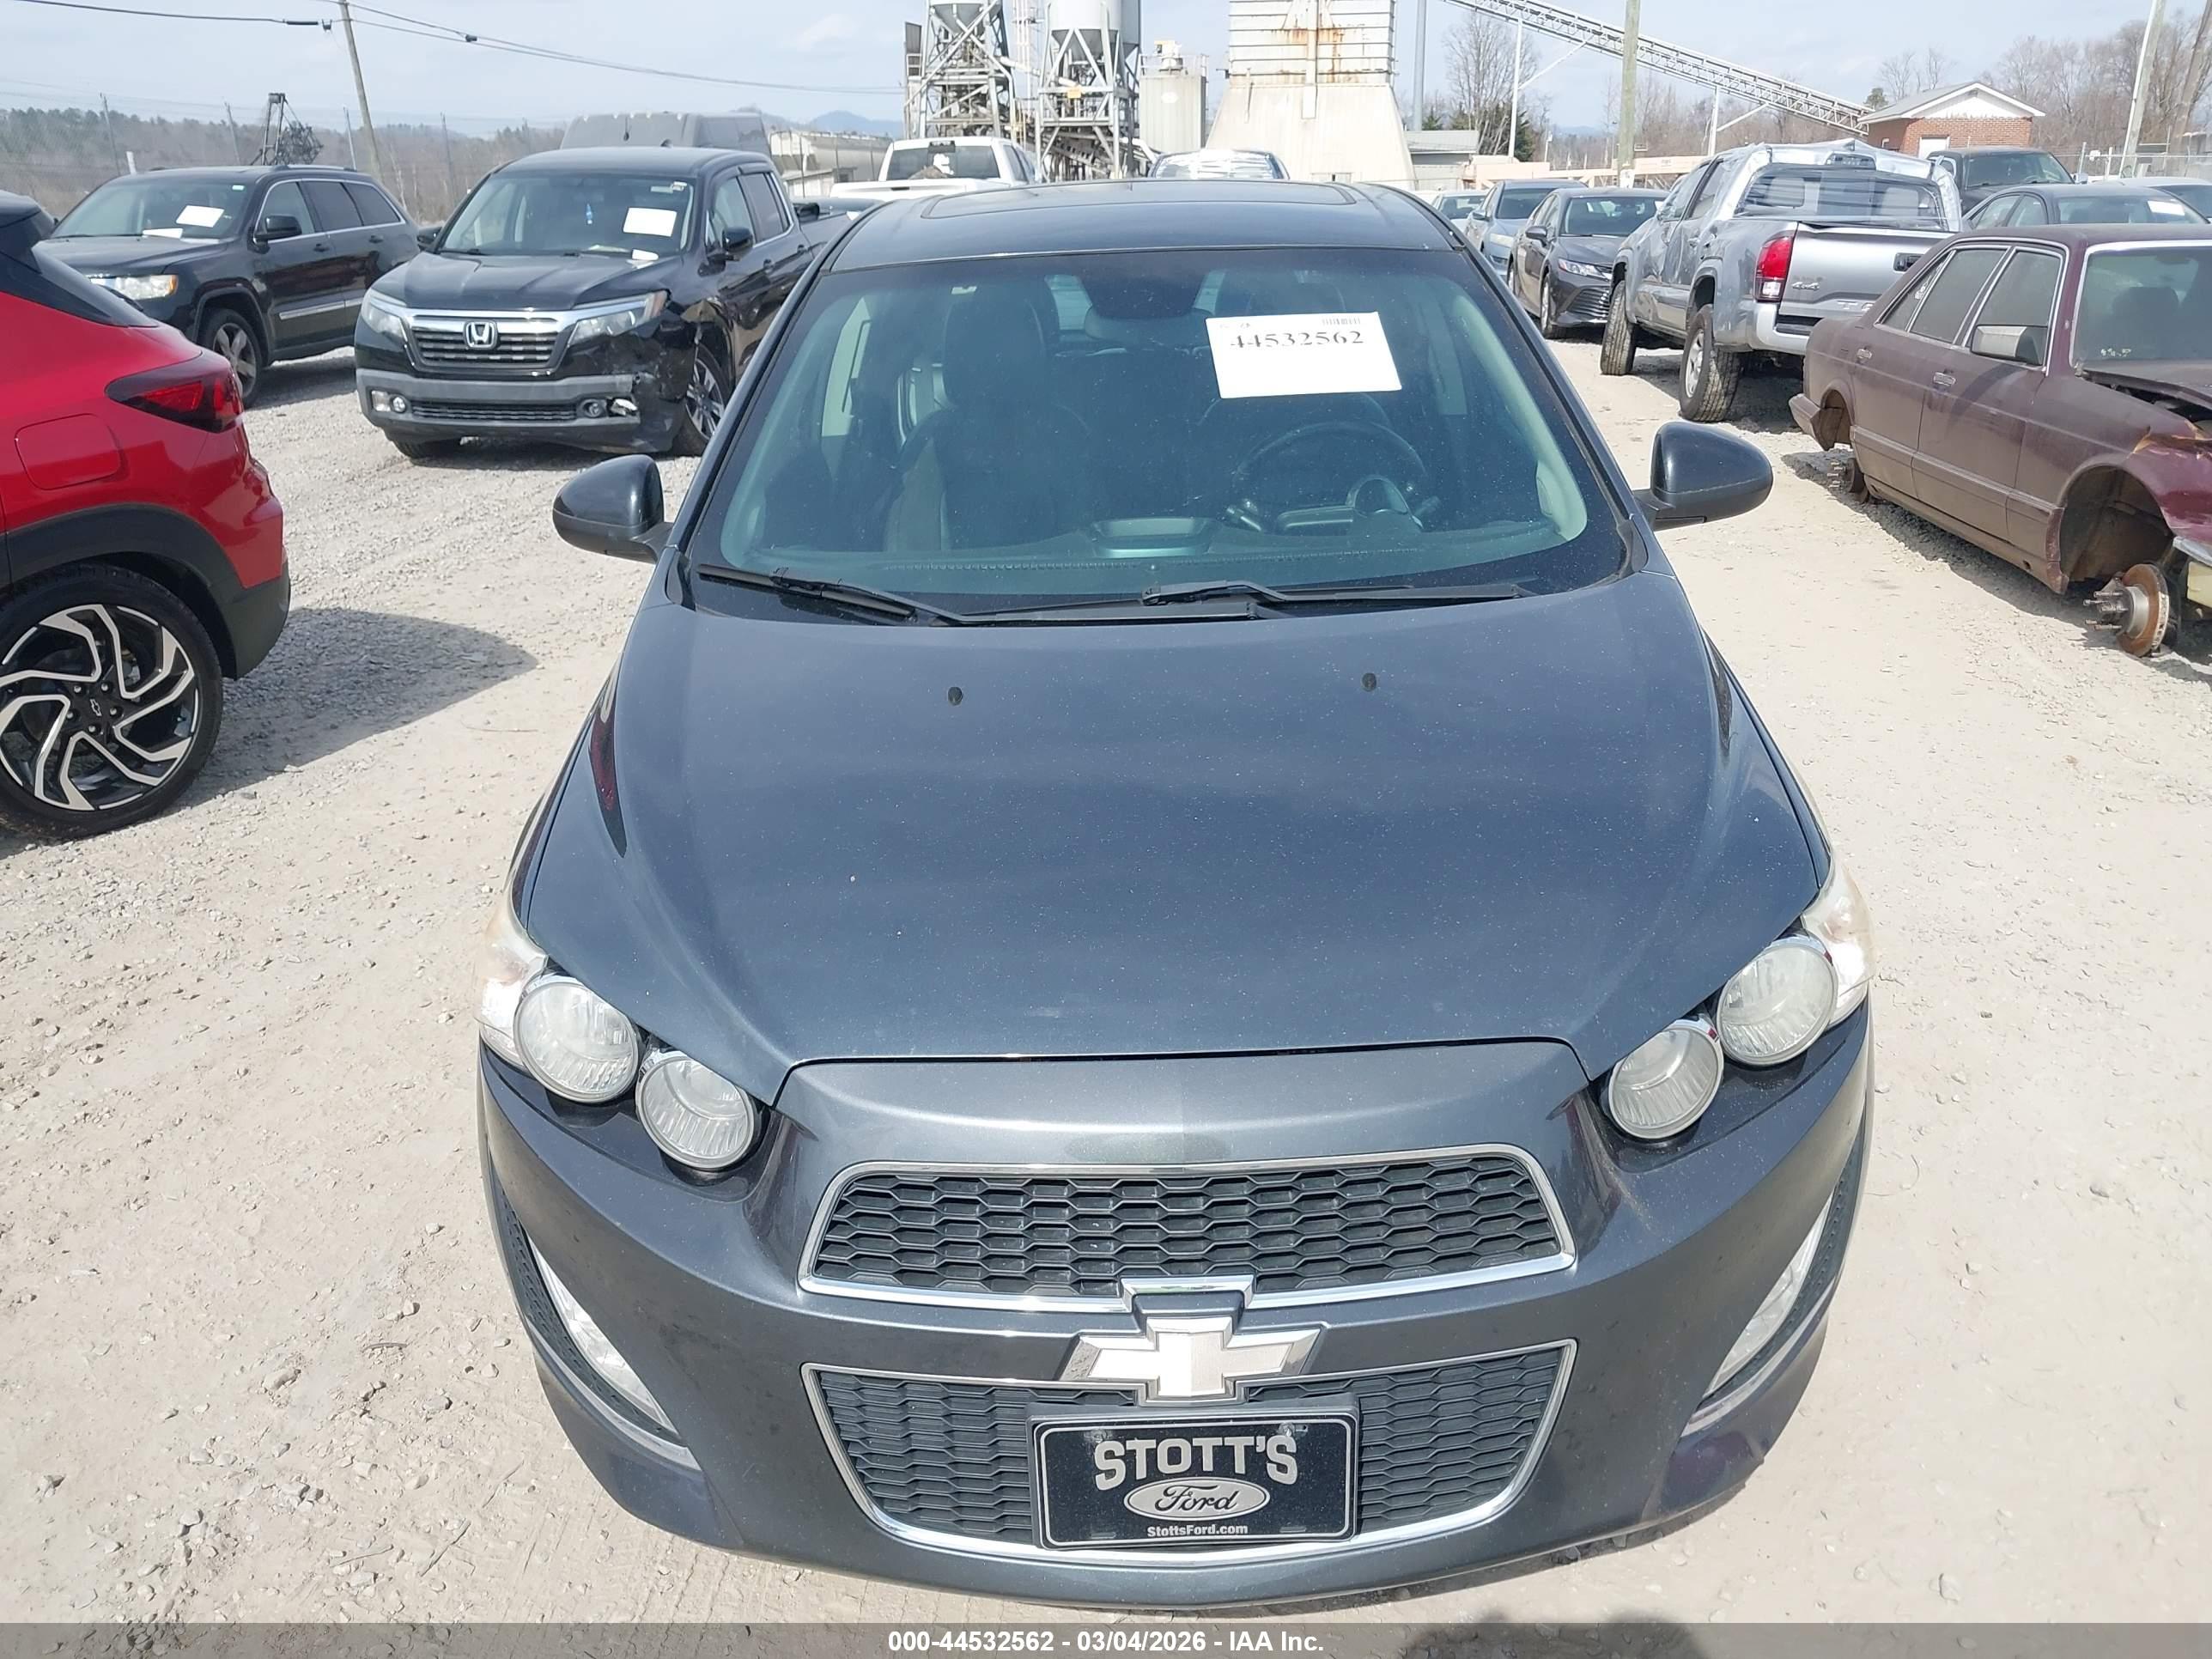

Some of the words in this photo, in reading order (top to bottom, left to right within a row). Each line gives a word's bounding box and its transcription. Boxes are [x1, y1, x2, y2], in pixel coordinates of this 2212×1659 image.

[1230, 330, 1364, 349] 44532562
[1095, 1435, 1297, 1491] STOTT'S
[1155, 1485, 1238, 1511] Ford
[1146, 1523, 1249, 1538] StottsFord.com
